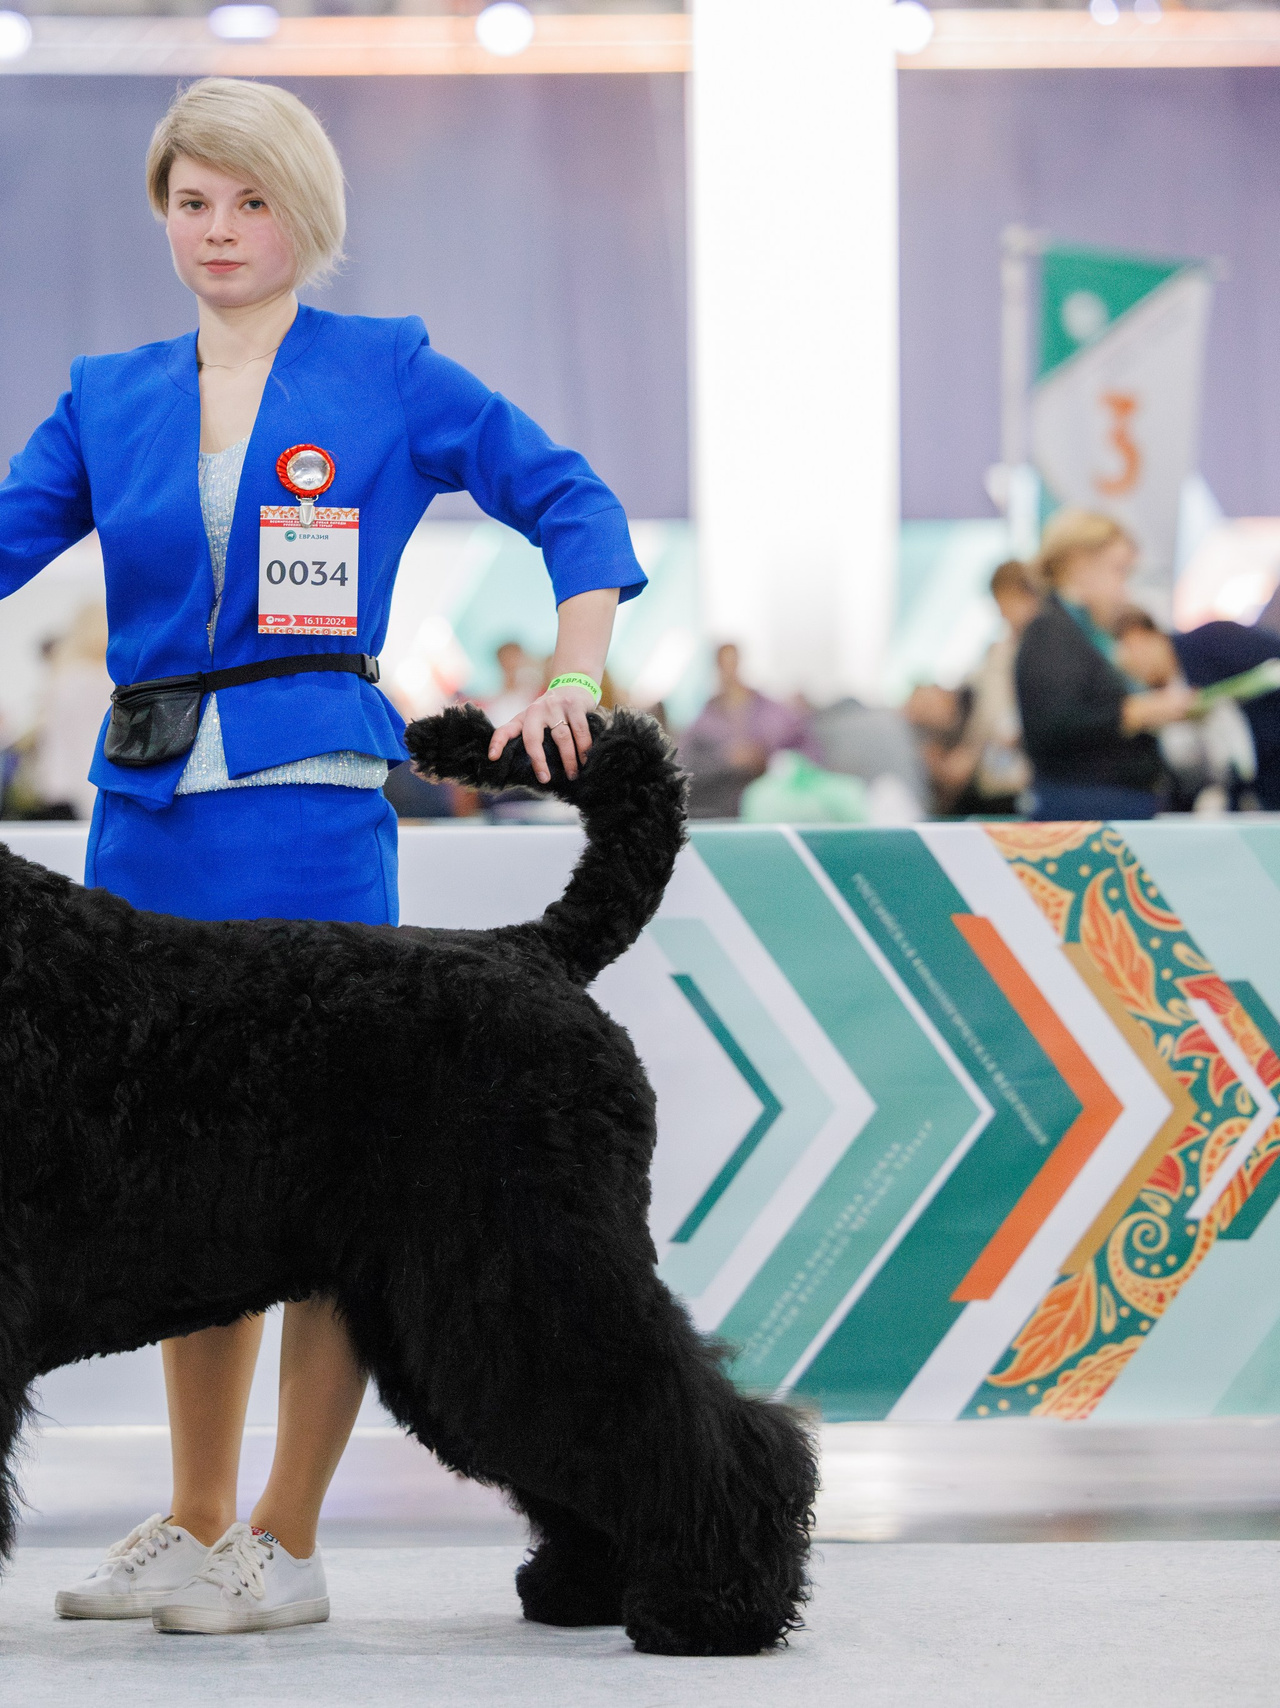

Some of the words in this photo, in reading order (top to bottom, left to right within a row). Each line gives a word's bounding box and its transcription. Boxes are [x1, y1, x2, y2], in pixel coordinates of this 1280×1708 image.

[1089, 391, 1145, 497] 3
[266, 559, 349, 587] 0034
[303, 617, 346, 625] 16.11.2024
[561, 677, 598, 694] ЕВРАЗИЯ
